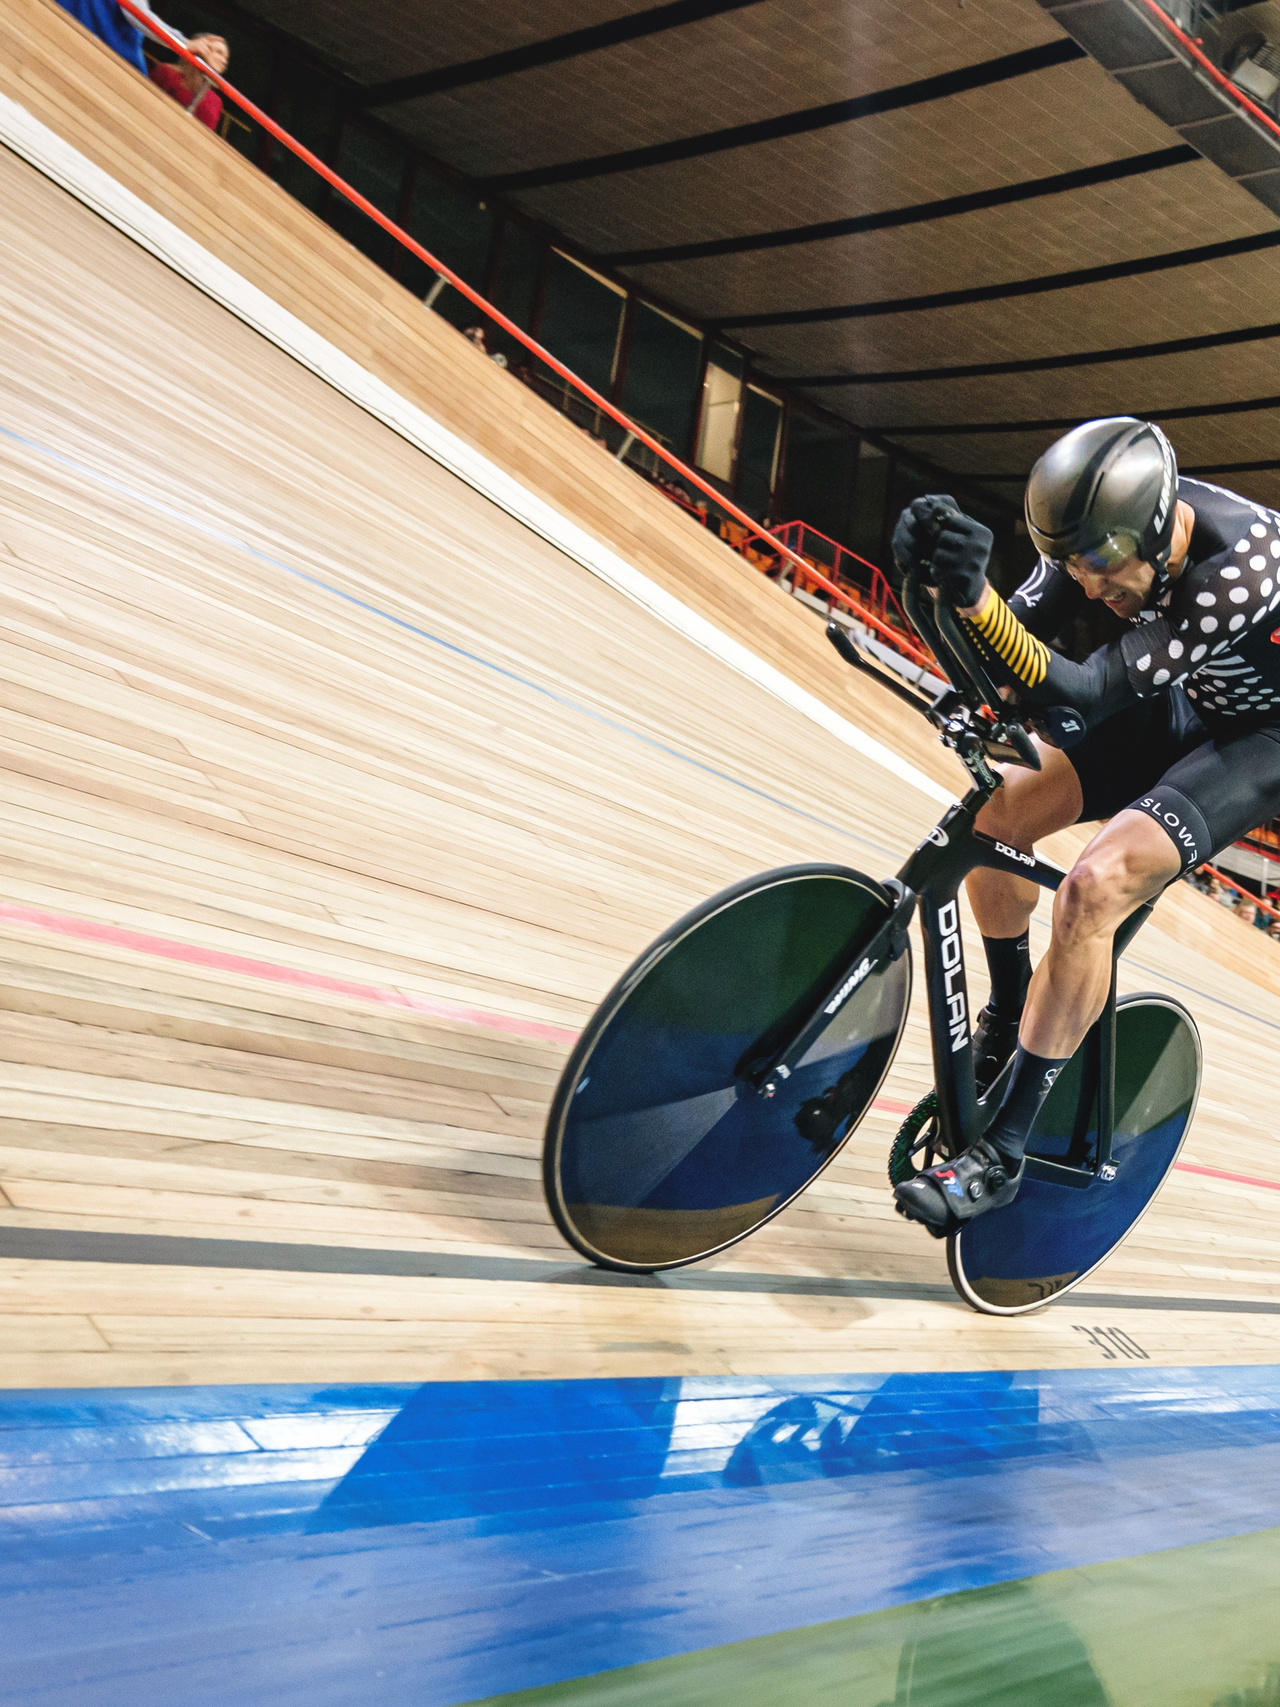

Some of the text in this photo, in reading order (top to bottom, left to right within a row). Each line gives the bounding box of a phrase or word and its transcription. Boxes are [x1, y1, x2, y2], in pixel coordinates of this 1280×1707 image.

[1061, 719, 1080, 732] 3T
[994, 841, 1036, 868] DOLAN
[937, 899, 969, 1053] DOLAN
[1069, 1324, 1151, 1360] 310
